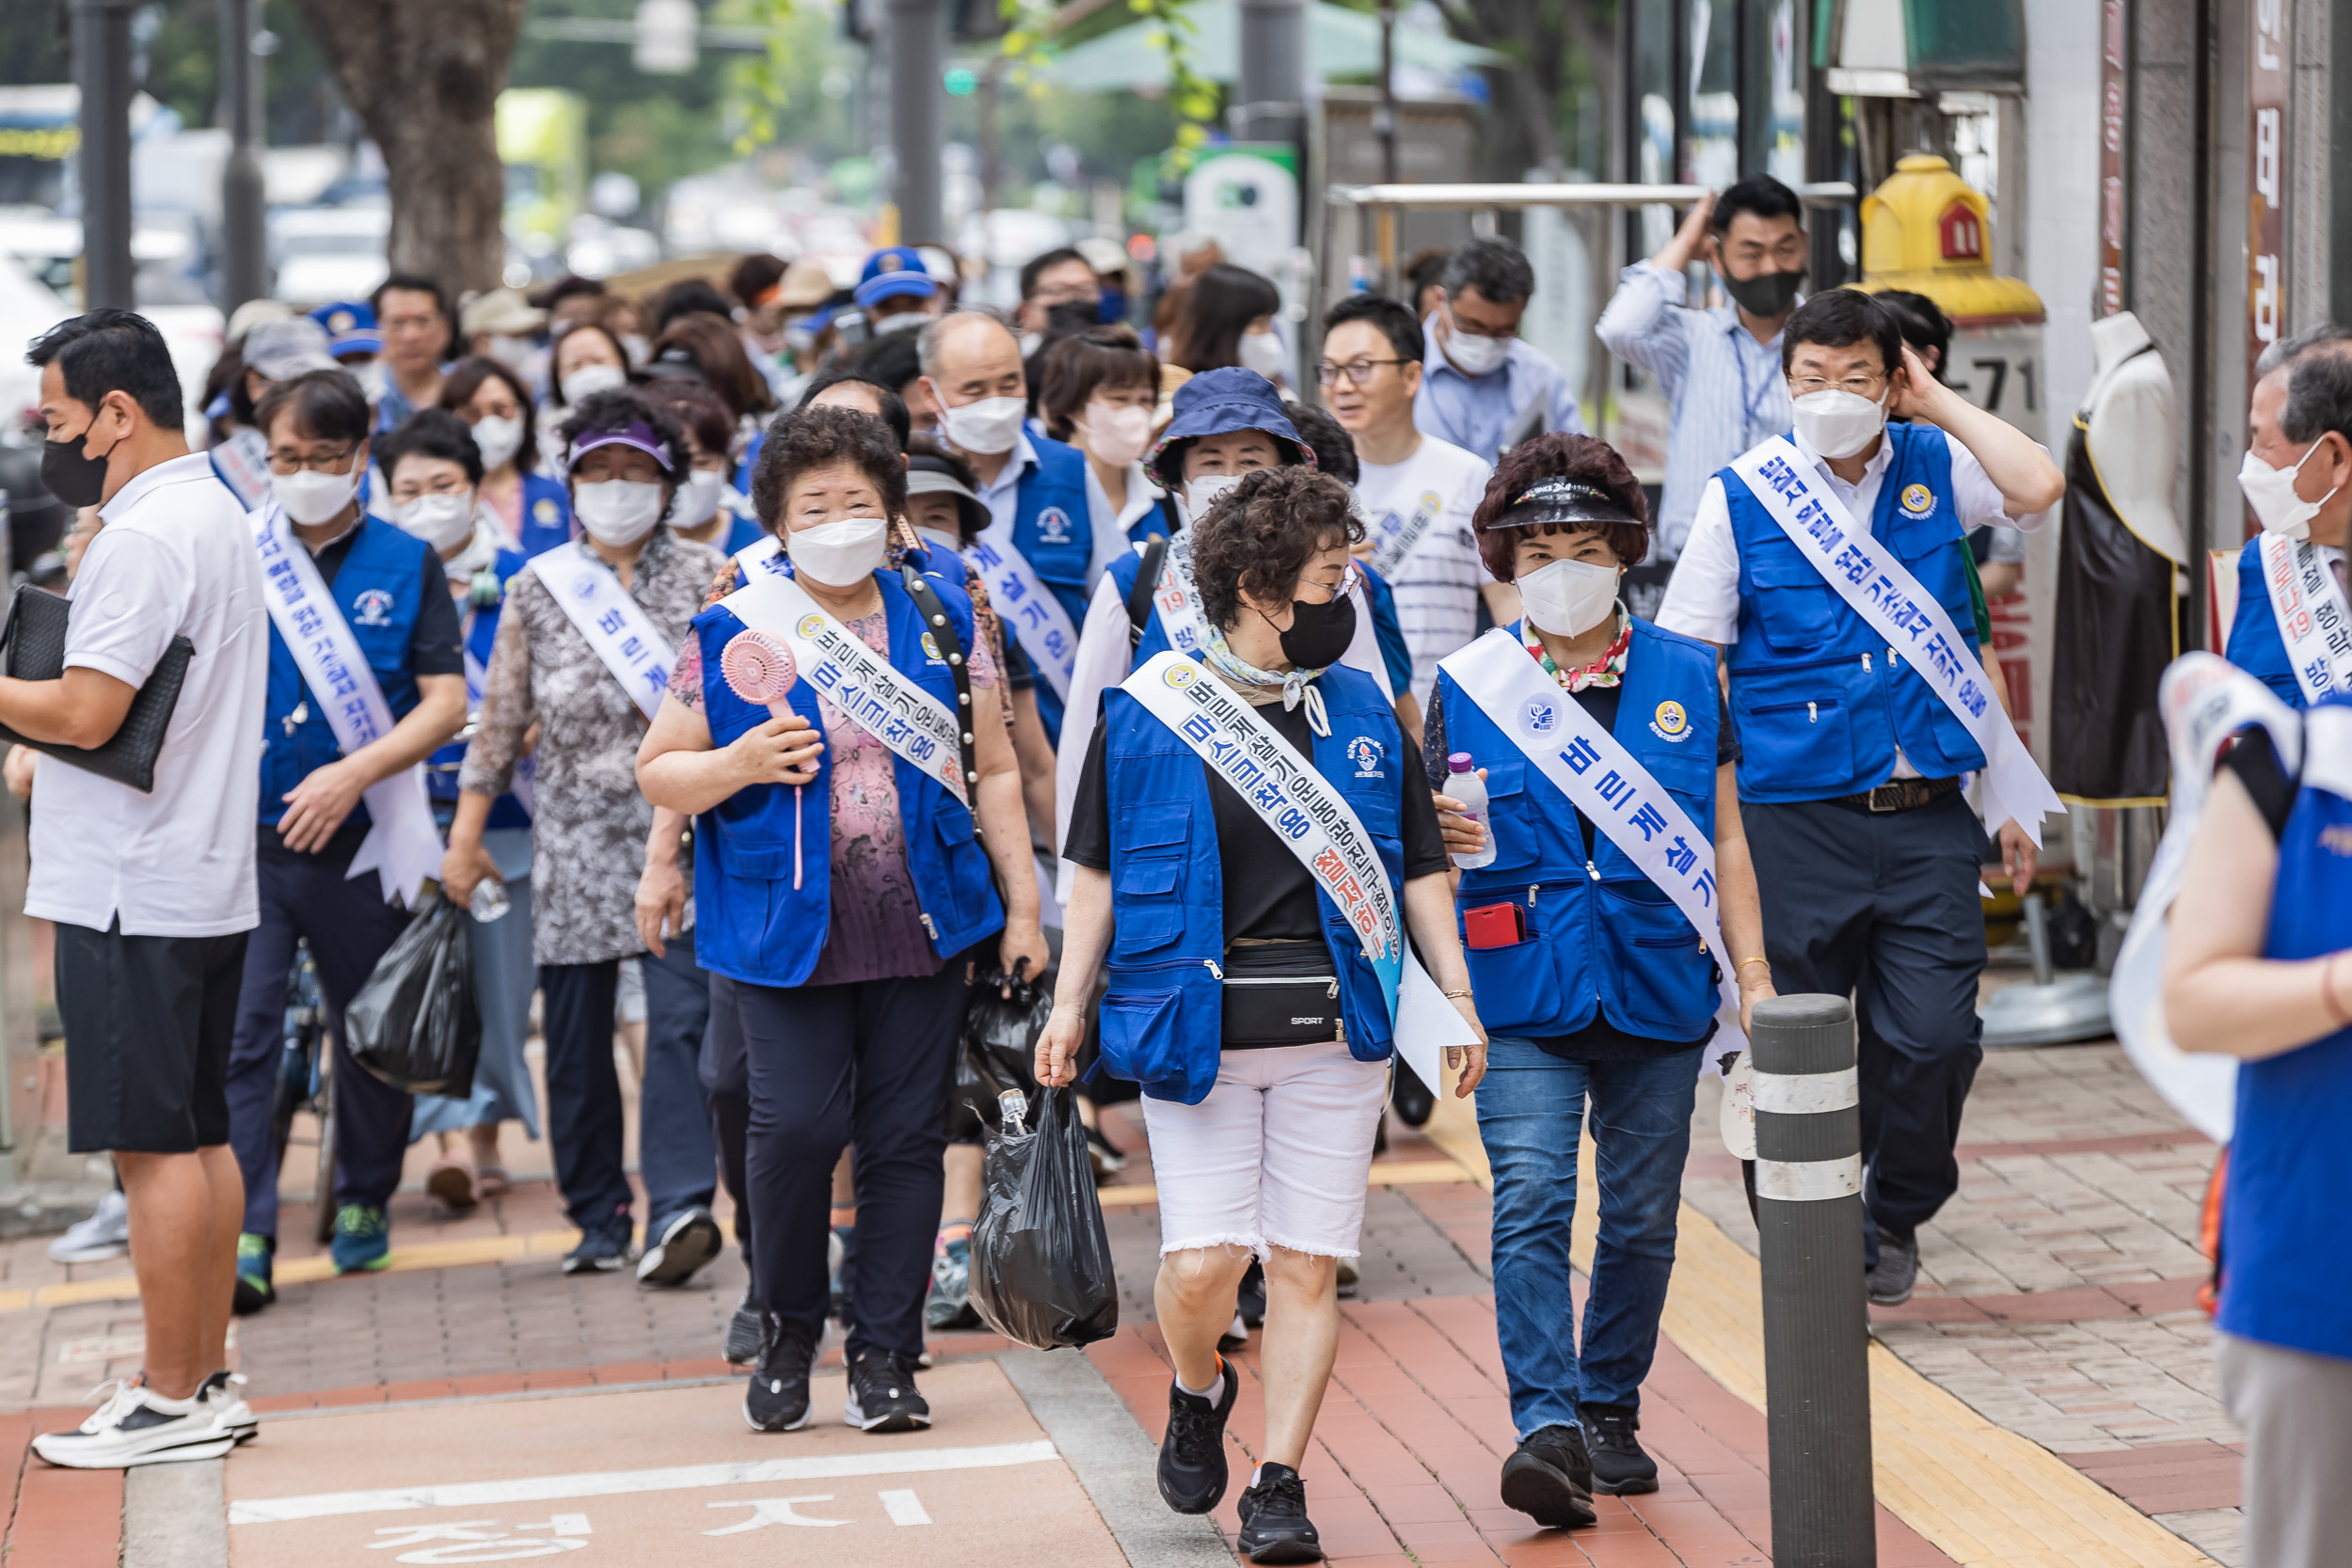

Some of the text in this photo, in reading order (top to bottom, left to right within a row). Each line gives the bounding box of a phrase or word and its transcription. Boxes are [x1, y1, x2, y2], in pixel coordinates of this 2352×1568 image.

[813, 660, 936, 761] 마스크착용
[1182, 713, 1385, 960] 마스크착용 철저히!
[1559, 735, 1721, 927] 바르게살기
[1290, 1017, 1325, 1025] SPORT
